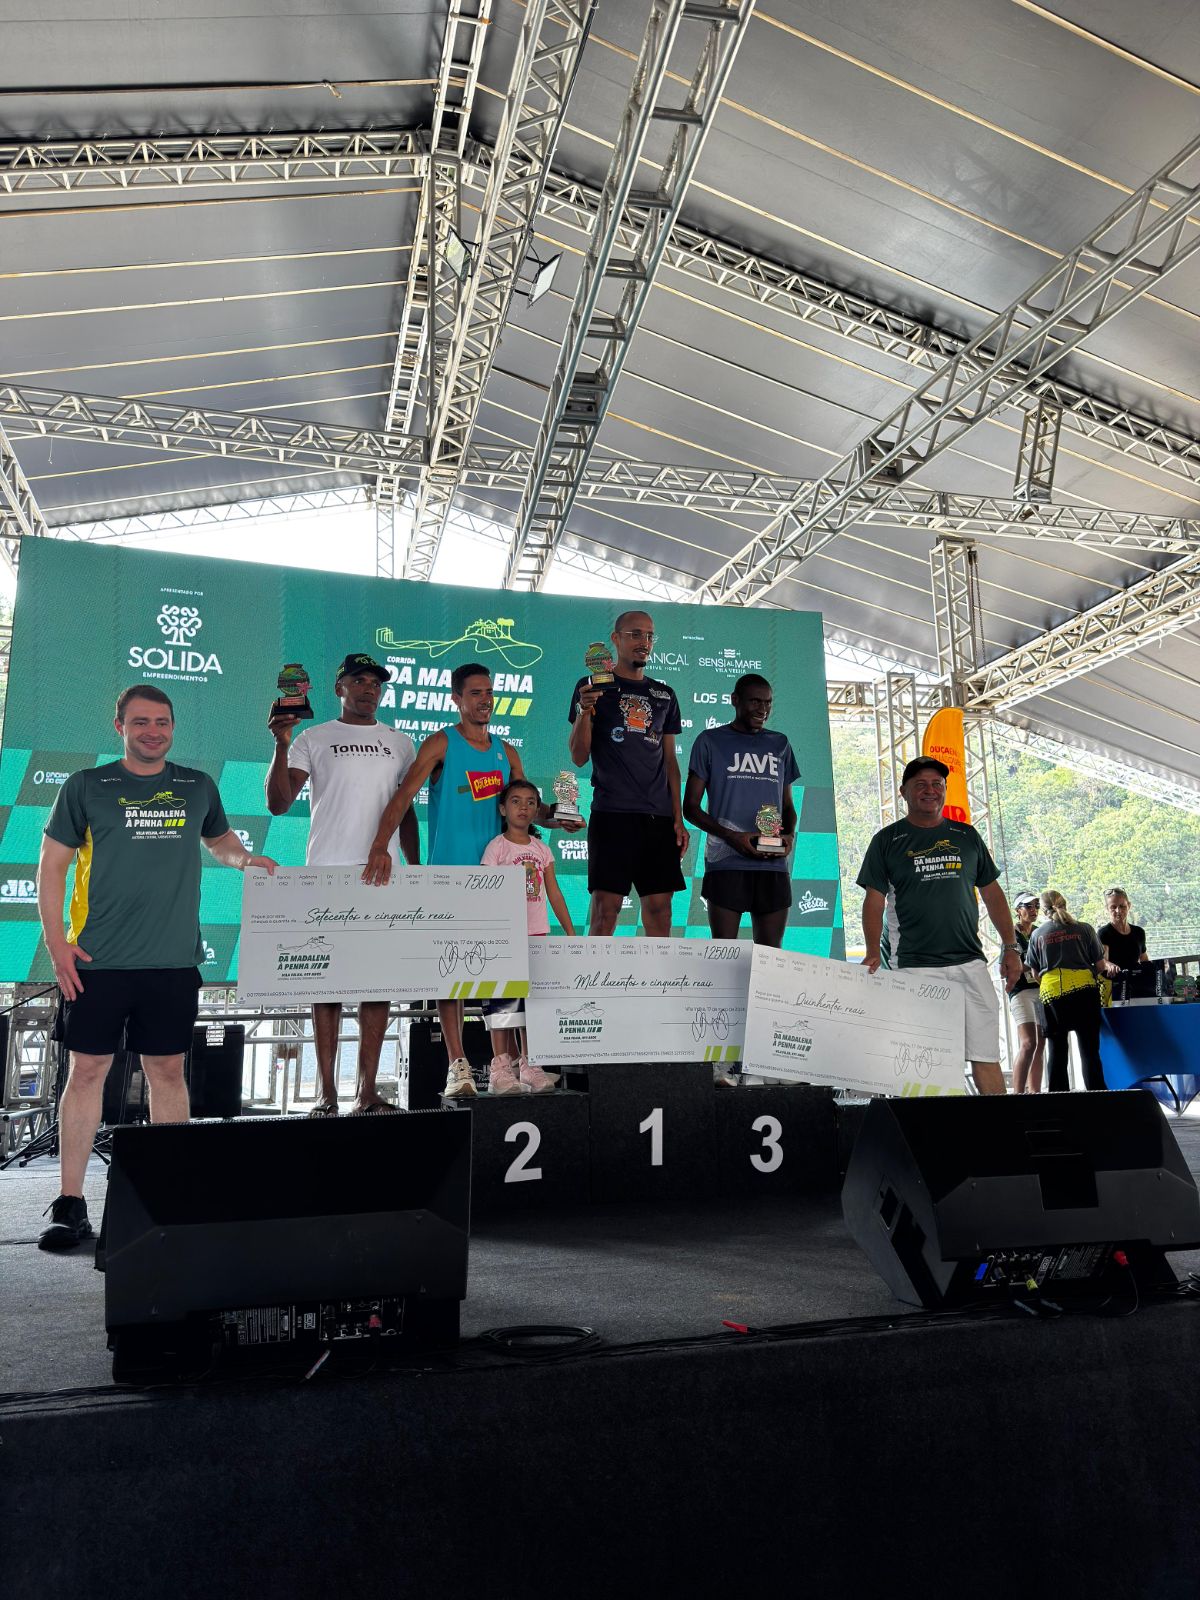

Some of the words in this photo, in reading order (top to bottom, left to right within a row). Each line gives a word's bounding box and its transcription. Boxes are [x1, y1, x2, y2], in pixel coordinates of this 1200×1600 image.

[127, 646, 223, 674] SOLIDA
[386, 655, 416, 665] CORRIDA
[646, 652, 689, 666] ANICAL
[734, 659, 762, 670] MARE
[142, 671, 208, 682] EMPREENDIMENTOS
[384, 664, 412, 685] DA
[417, 667, 534, 694] MAENA
[379, 684, 396, 708] À
[401, 690, 460, 712] PENH
[693, 692, 717, 704] LOS
[394, 718, 419, 731] VILA
[125, 809, 138, 818] DA
[139, 809, 187, 818] MADALENA
[125, 818, 132, 828] À
[134, 819, 163, 828] PENHA
[925, 855, 962, 864] MADALENA
[921, 863, 945, 872] PENHA
[304, 906, 361, 927] Setecentos
[363, 913, 372, 921] e
[374, 906, 426, 929] cinquenta
[427, 911, 455, 920] reais
[289, 954, 331, 962] MADALENA
[277, 961, 283, 970] À
[284, 962, 309, 970] PENHA
[573, 970, 601, 990] Mil
[649, 974, 691, 994] cinquenta
[792, 991, 843, 1015] Quinhentos
[844, 1006, 866, 1016] reais
[564, 1026, 586, 1034] PENHA
[782, 1034, 812, 1045] MADALENA
[777, 1041, 796, 1050] PENHA
[504, 1121, 543, 1183] 2
[639, 1107, 664, 1166] 1
[749, 1115, 784, 1173] 3
